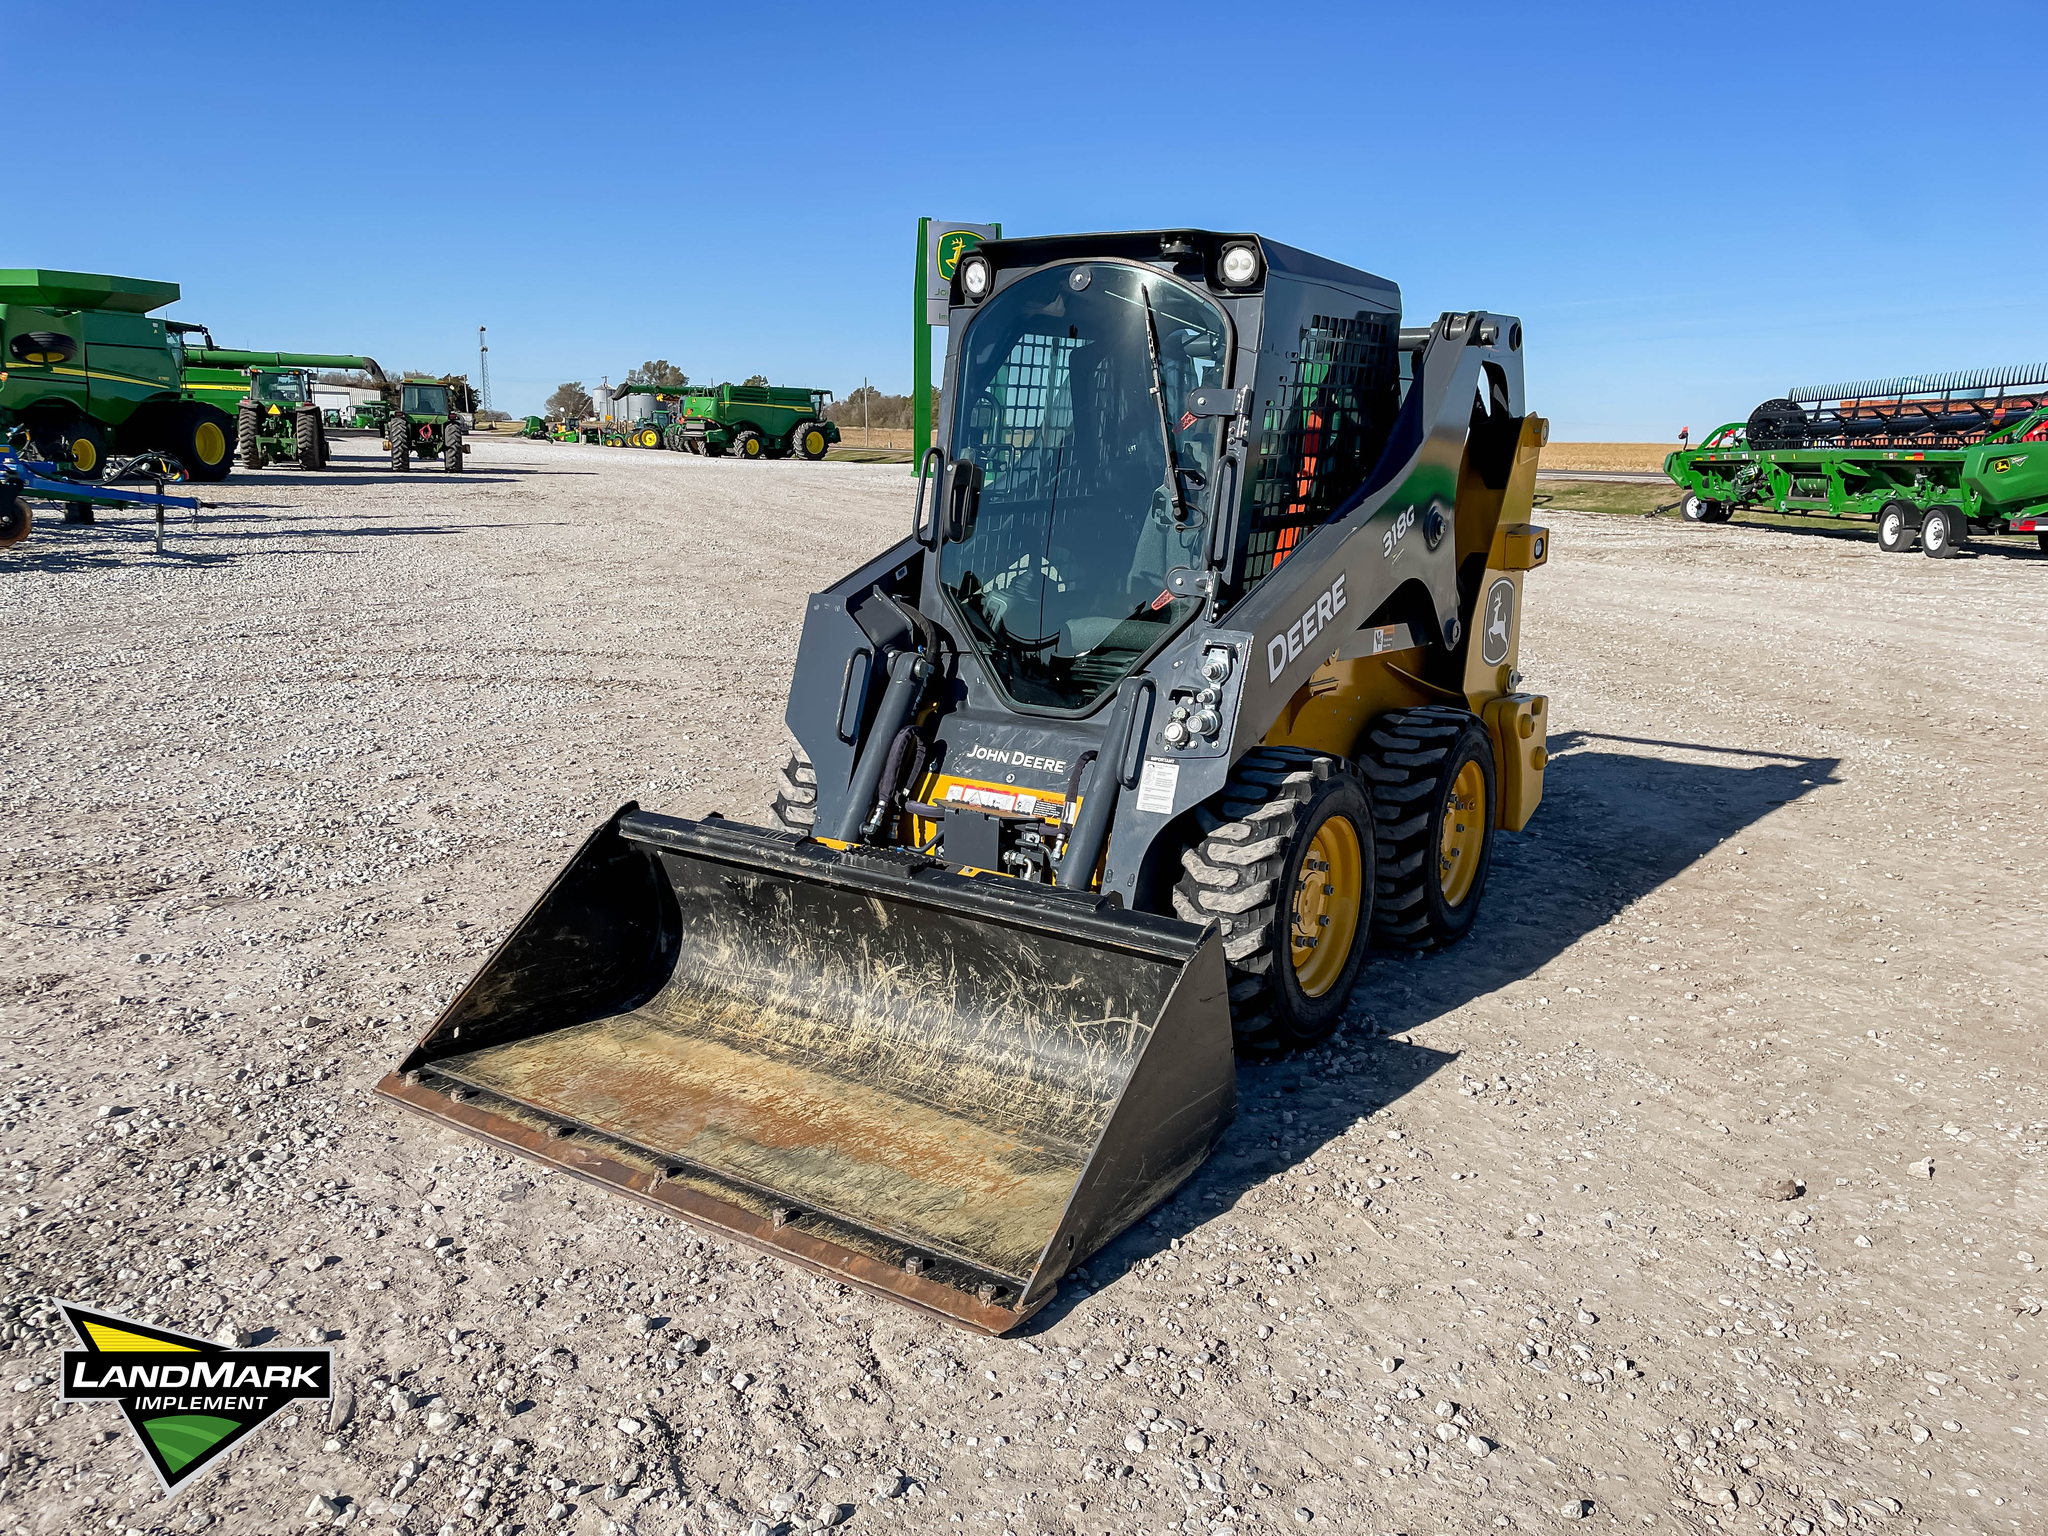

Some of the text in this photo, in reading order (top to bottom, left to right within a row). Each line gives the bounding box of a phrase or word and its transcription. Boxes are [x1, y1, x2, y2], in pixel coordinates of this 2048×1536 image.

[934, 288, 949, 296] JO
[1382, 504, 1415, 558] 318G
[1267, 573, 1348, 684] DEERE
[966, 744, 1067, 773] JOHN DEERE
